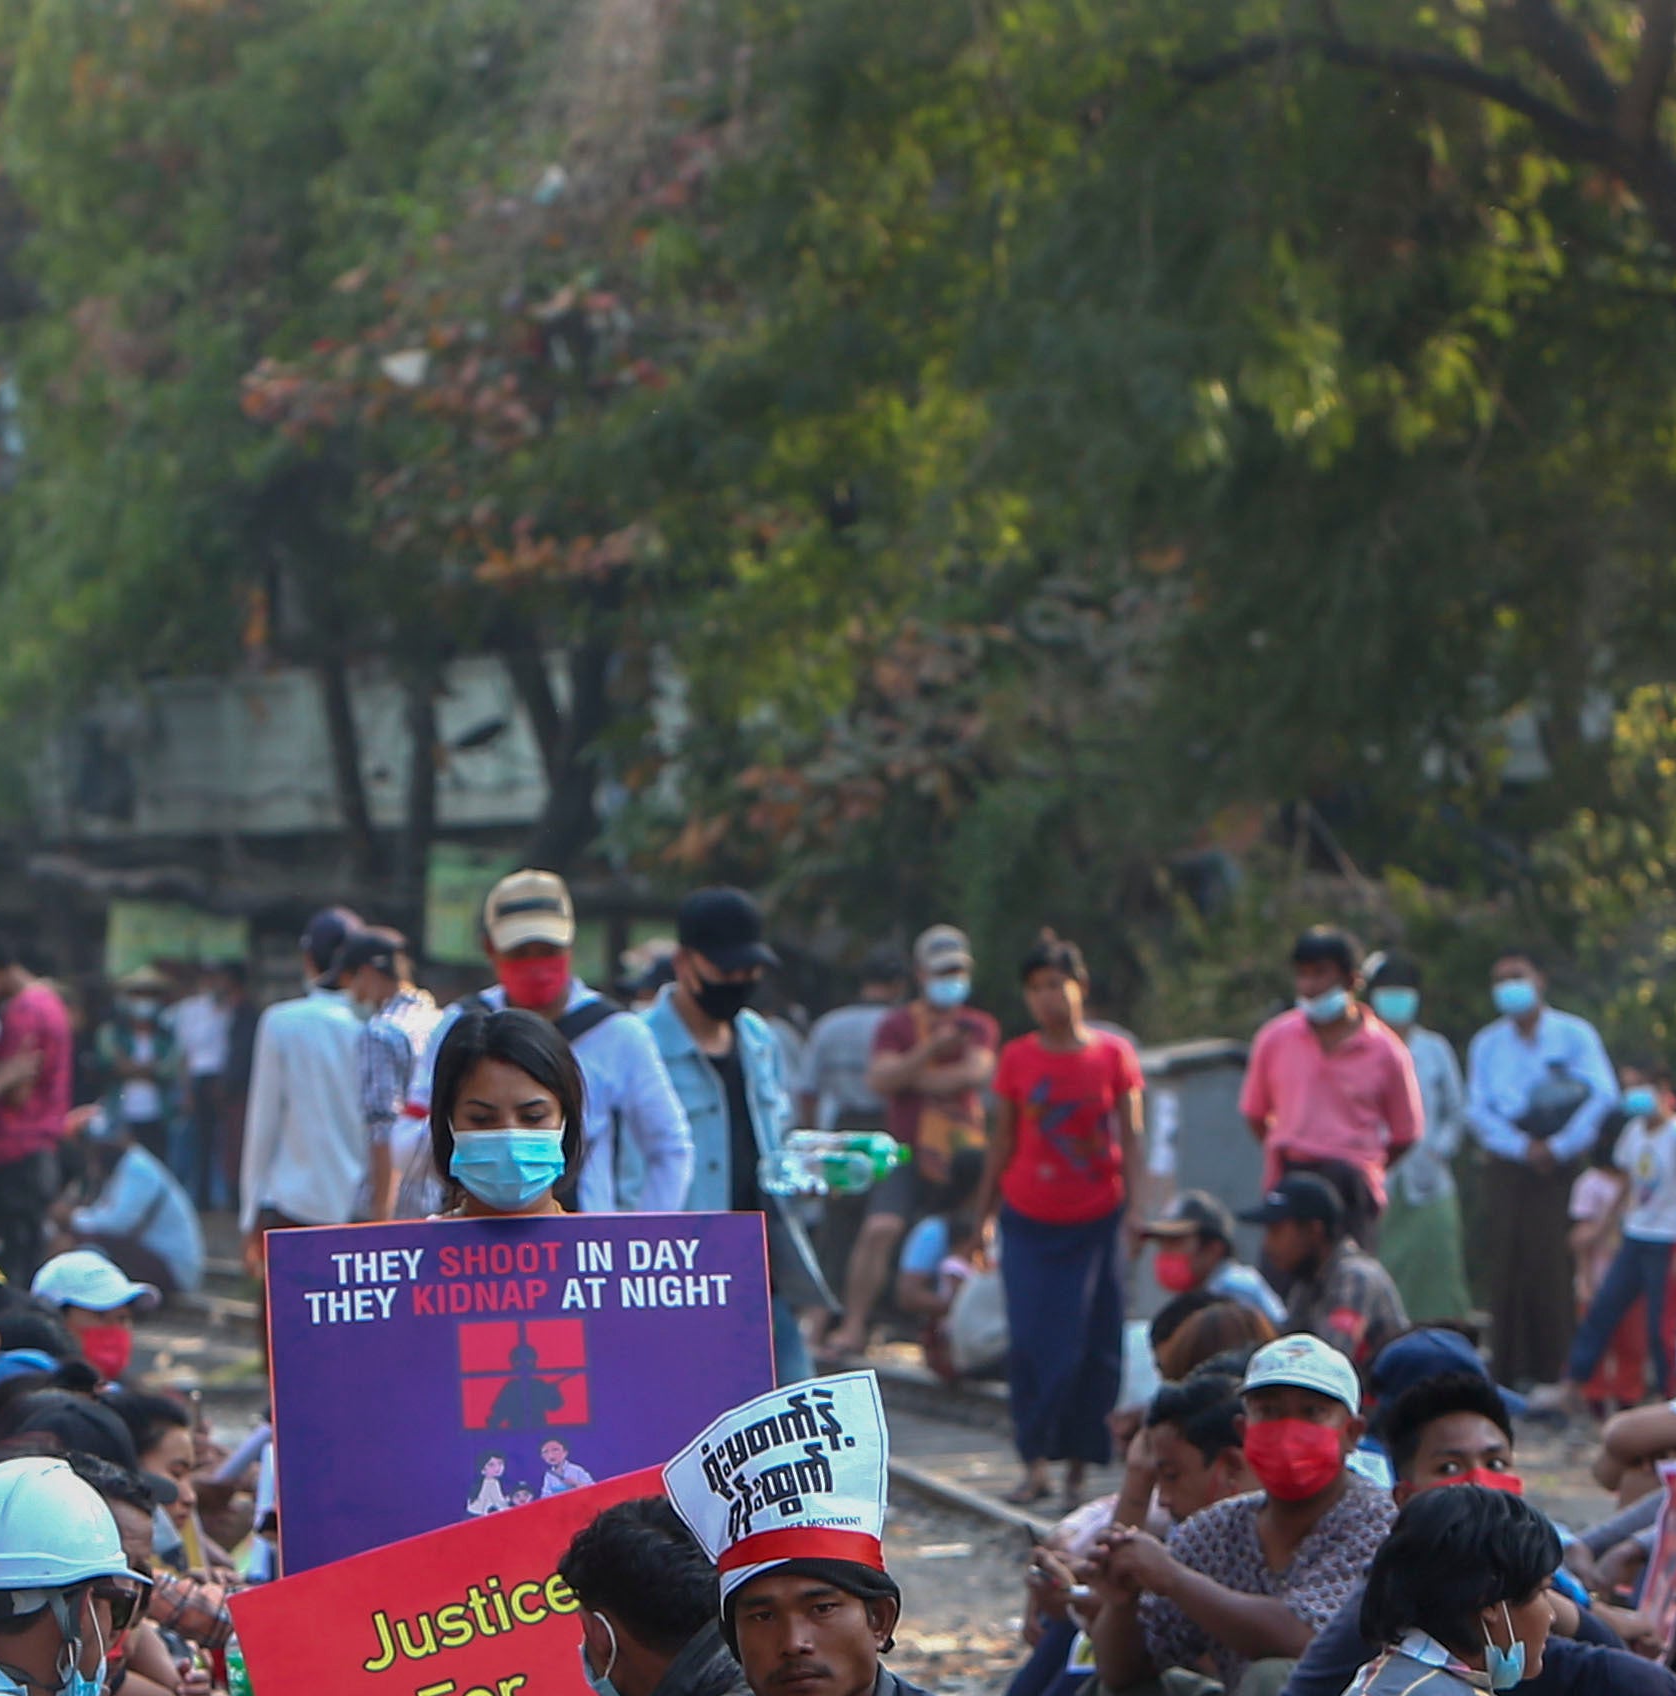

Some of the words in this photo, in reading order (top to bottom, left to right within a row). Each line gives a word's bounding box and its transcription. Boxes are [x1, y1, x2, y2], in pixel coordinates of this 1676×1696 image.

[331, 1249, 424, 1285] THEY
[438, 1242, 563, 1278] SHOOT
[576, 1241, 614, 1272] IN
[628, 1239, 700, 1271] DAY
[304, 1287, 397, 1324] THEY
[412, 1280, 549, 1316] KIDNAP
[561, 1277, 606, 1309] AT
[620, 1274, 732, 1308] NIGHT
[362, 1573, 581, 1673] Justice
